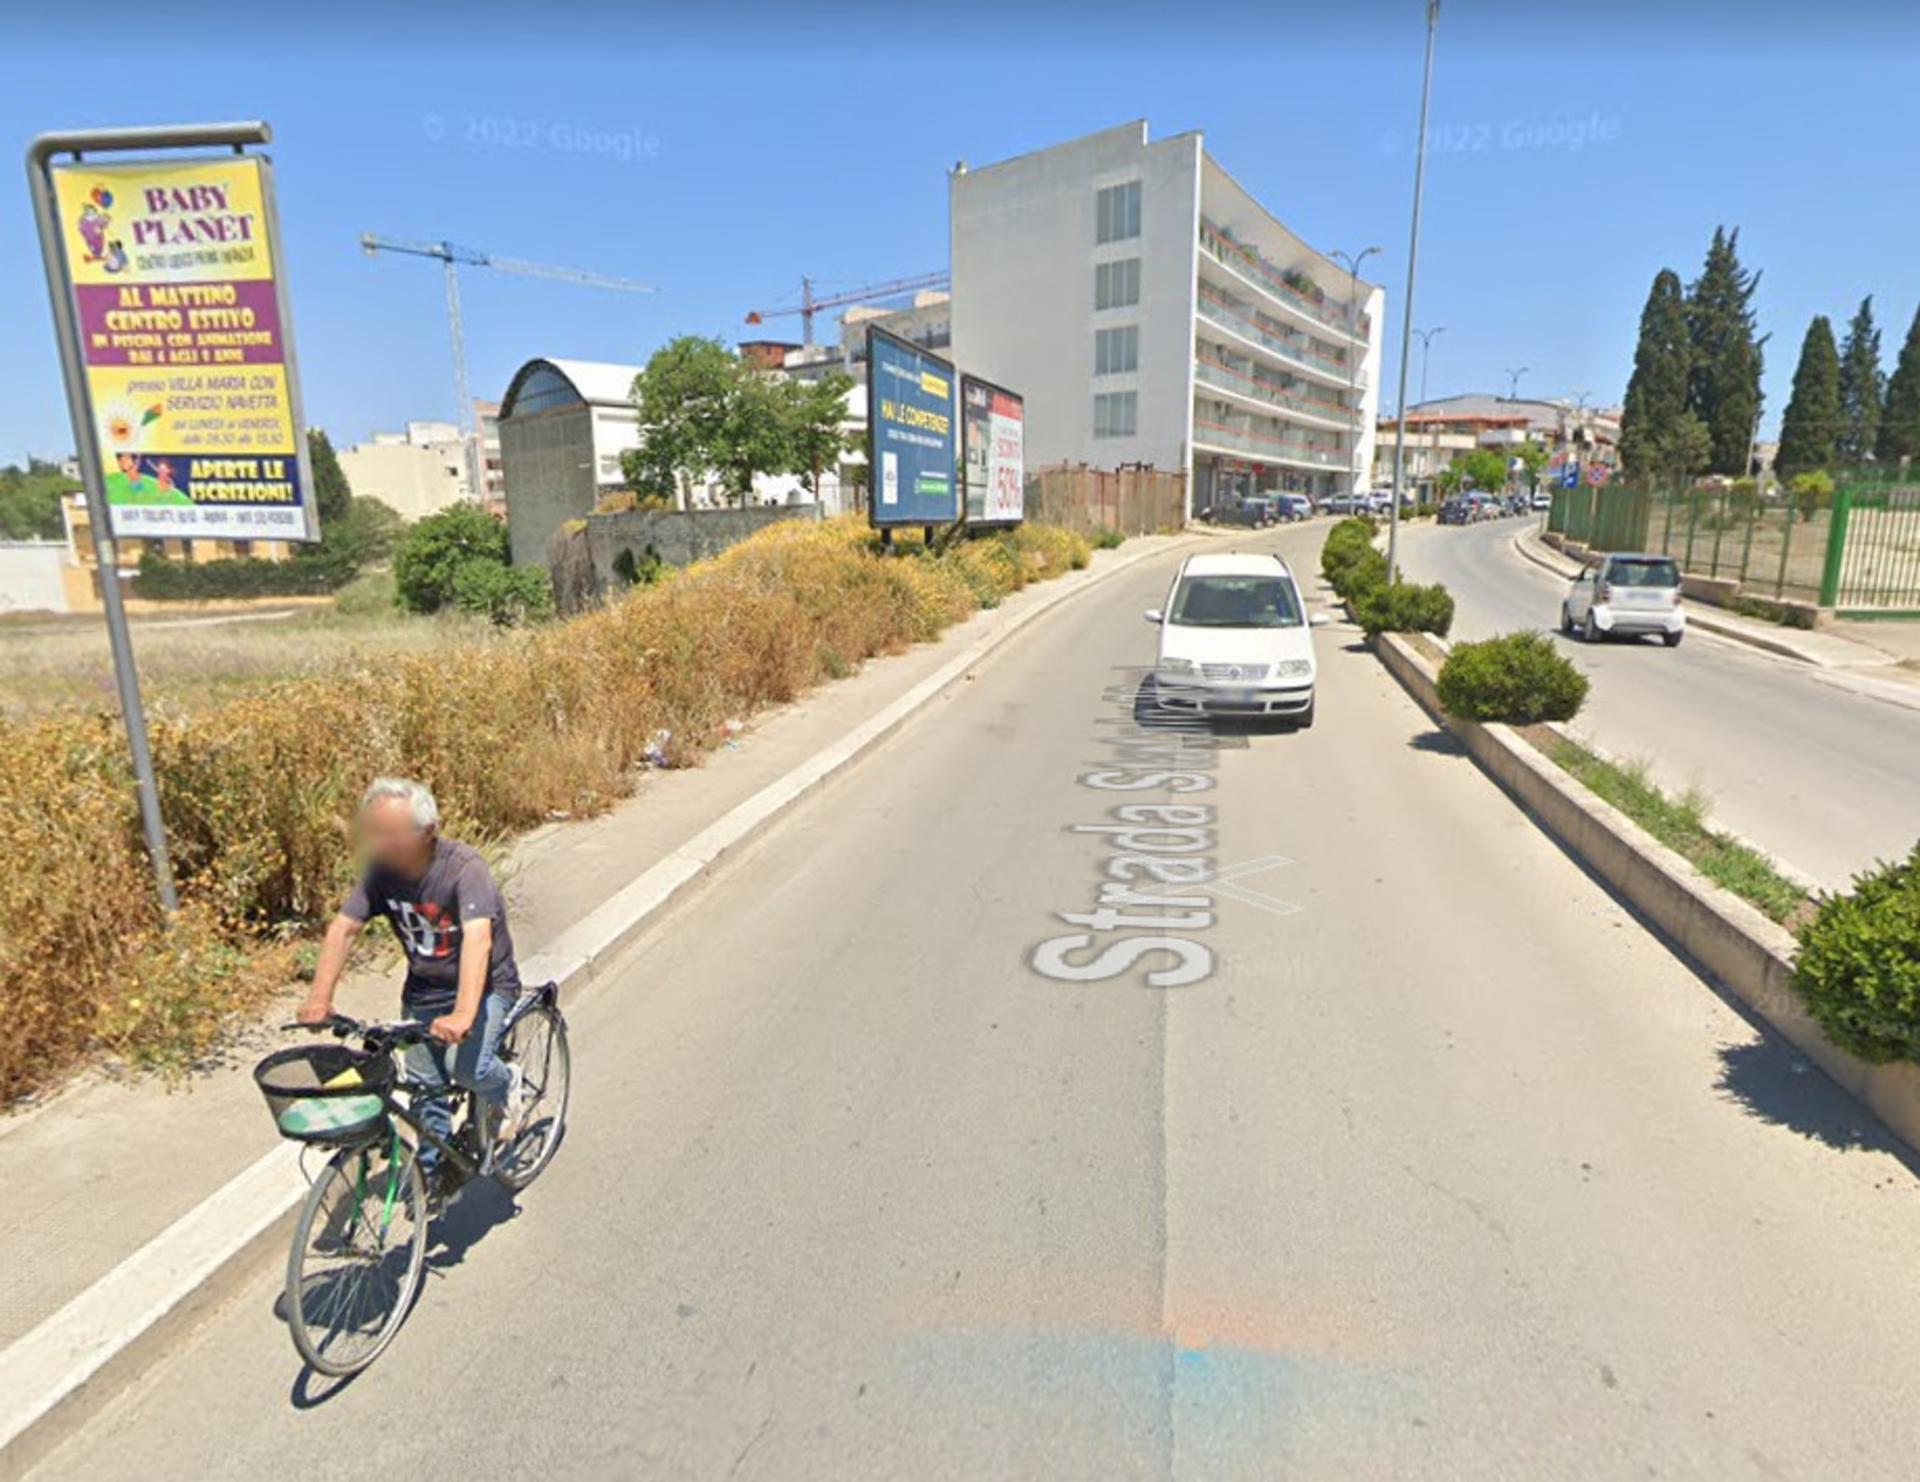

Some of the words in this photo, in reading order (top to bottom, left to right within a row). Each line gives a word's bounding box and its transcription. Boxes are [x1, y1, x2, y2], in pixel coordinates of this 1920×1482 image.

[145, 184, 229, 214] BABY
[132, 215, 253, 246] PLANET
[118, 287, 143, 308] AL
[150, 284, 237, 307] MATTINO
[105, 310, 182, 331] CENTRO
[189, 307, 256, 329] ESTIVO
[167, 376, 203, 392] VILLA
[207, 375, 247, 391] MARIA
[249, 375, 277, 390] CON
[166, 395, 223, 411] SERVIZIO
[227, 394, 279, 410] NAVETTA
[190, 459, 259, 479] APERTE
[263, 460, 284, 479] LE
[189, 482, 293, 502] ISCRIZIONI!
